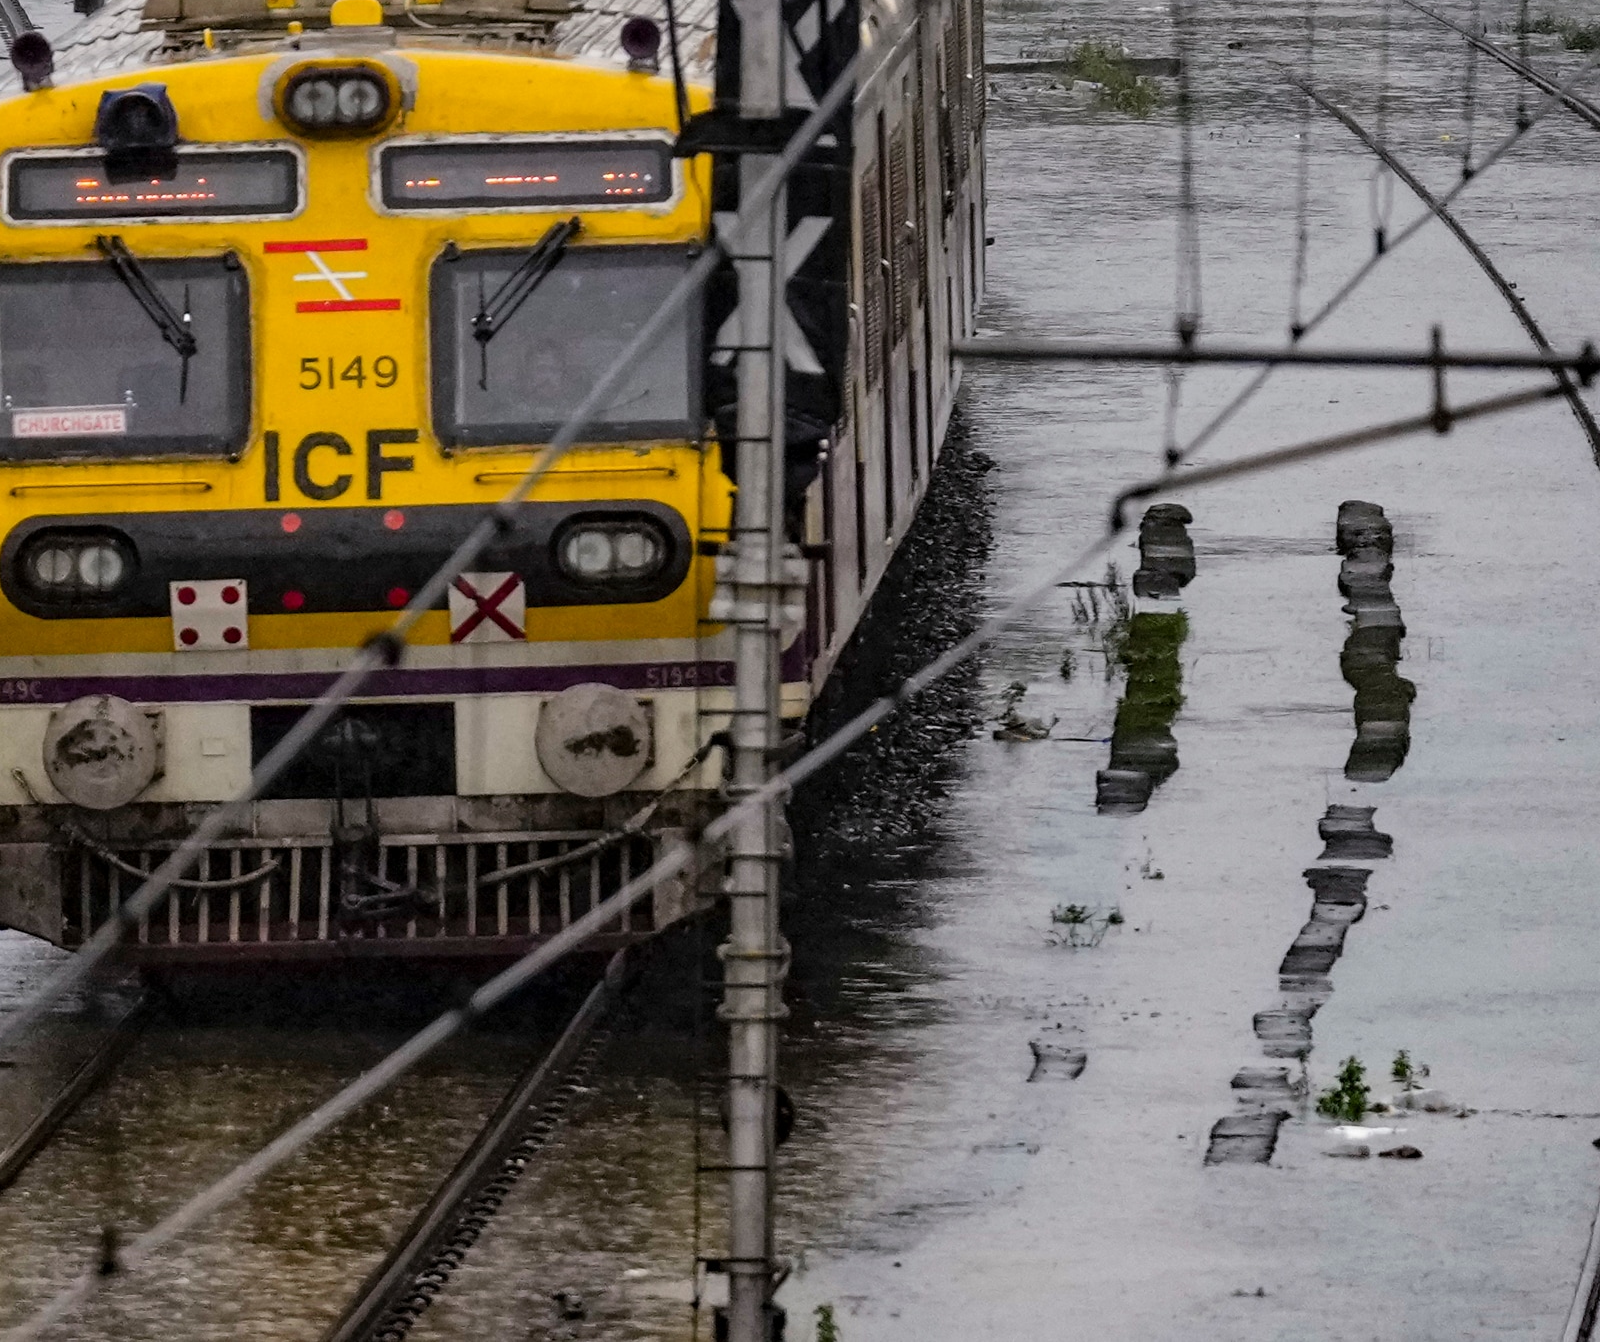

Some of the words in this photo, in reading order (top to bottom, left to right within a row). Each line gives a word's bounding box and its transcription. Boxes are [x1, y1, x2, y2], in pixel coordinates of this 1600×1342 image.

[300, 355, 399, 390] 5149
[19, 414, 122, 433] CHURCHGATE
[264, 428, 420, 502] ICF
